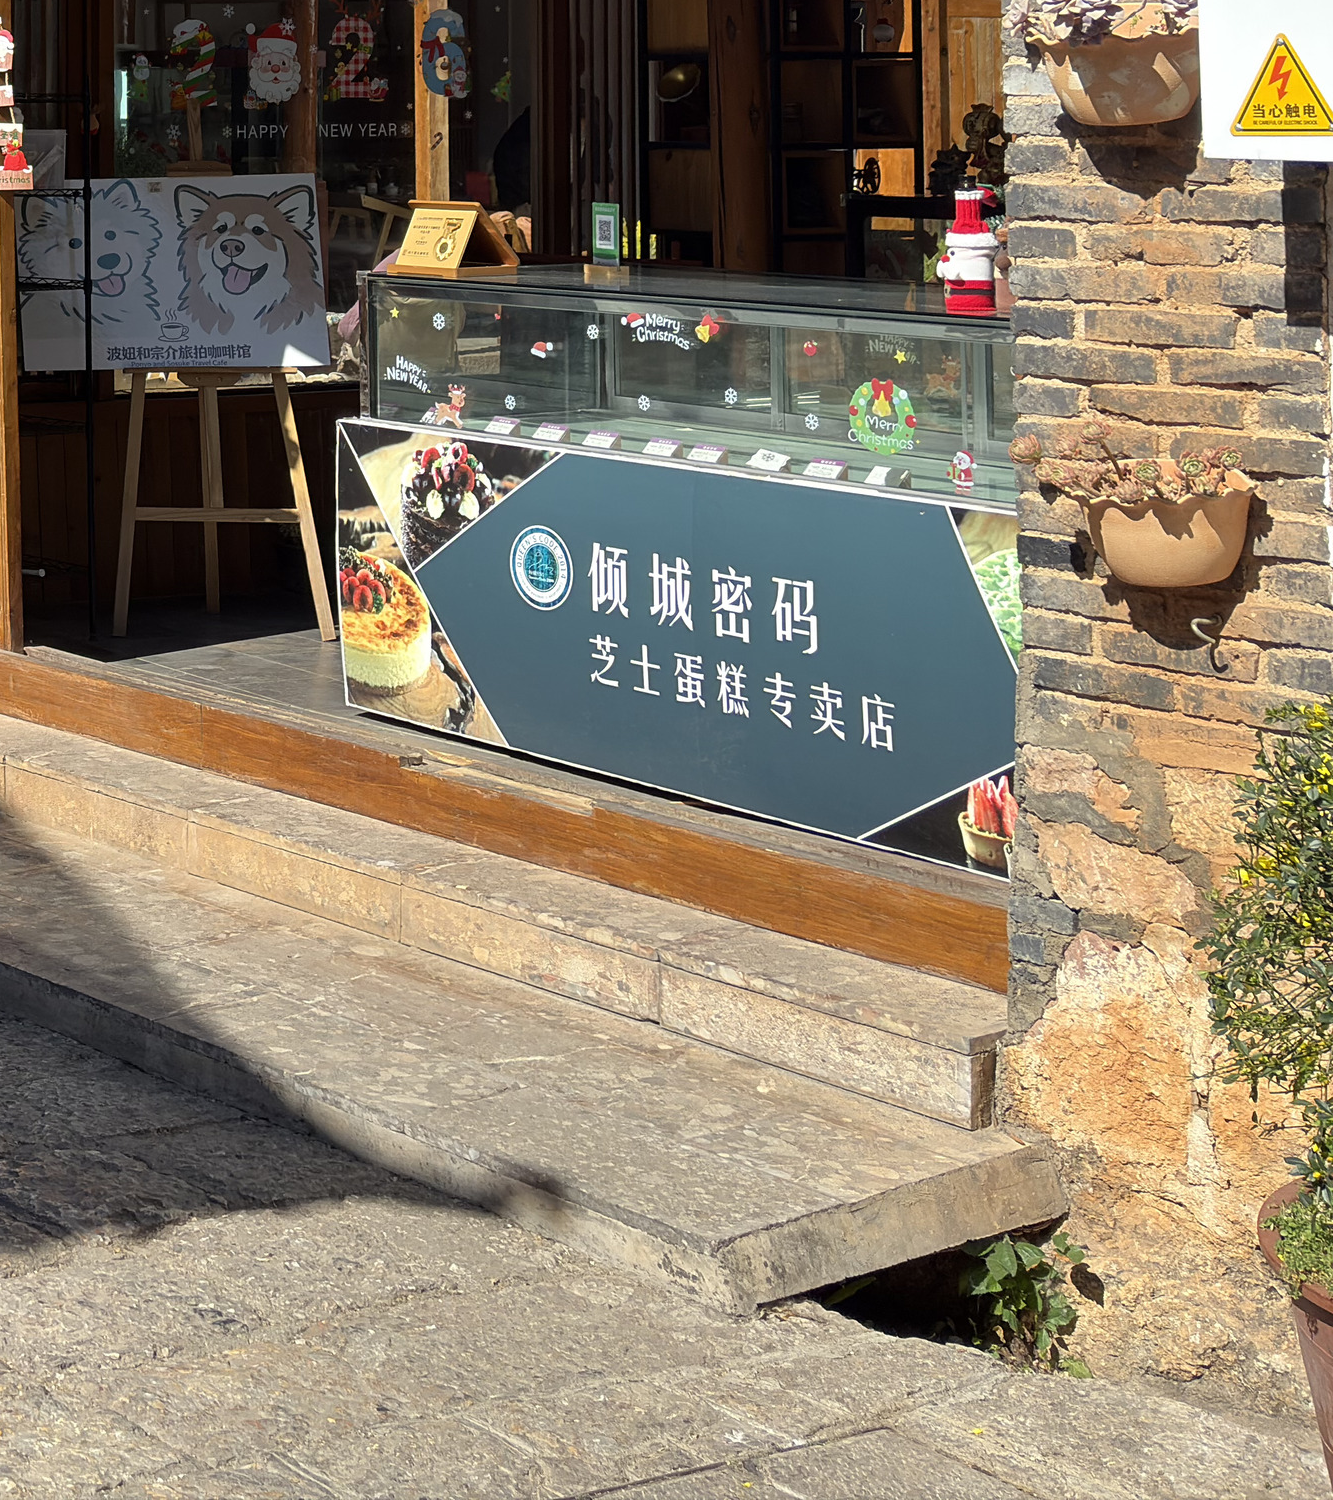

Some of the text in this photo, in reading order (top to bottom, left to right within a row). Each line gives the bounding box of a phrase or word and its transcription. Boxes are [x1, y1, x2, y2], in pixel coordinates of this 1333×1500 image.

[1253, 103, 1318, 118] 当心触电
[236, 123, 397, 139] HAPPY NEW YEAR
[645, 313, 681, 333] Merry
[636, 327, 690, 350] Christmas
[868, 339, 894, 353] NEW
[107, 344, 251, 361] 波妞和宗介旅拍咖啡馆
[396, 355, 422, 375] HAPPY
[386, 366, 428, 393] NEW YEAR
[865, 415, 904, 432] Merry
[847, 428, 914, 450] Christmas
[587, 542, 819, 655] 倾城密码
[588, 634, 896, 752] 芝士蛋糕专卖店
